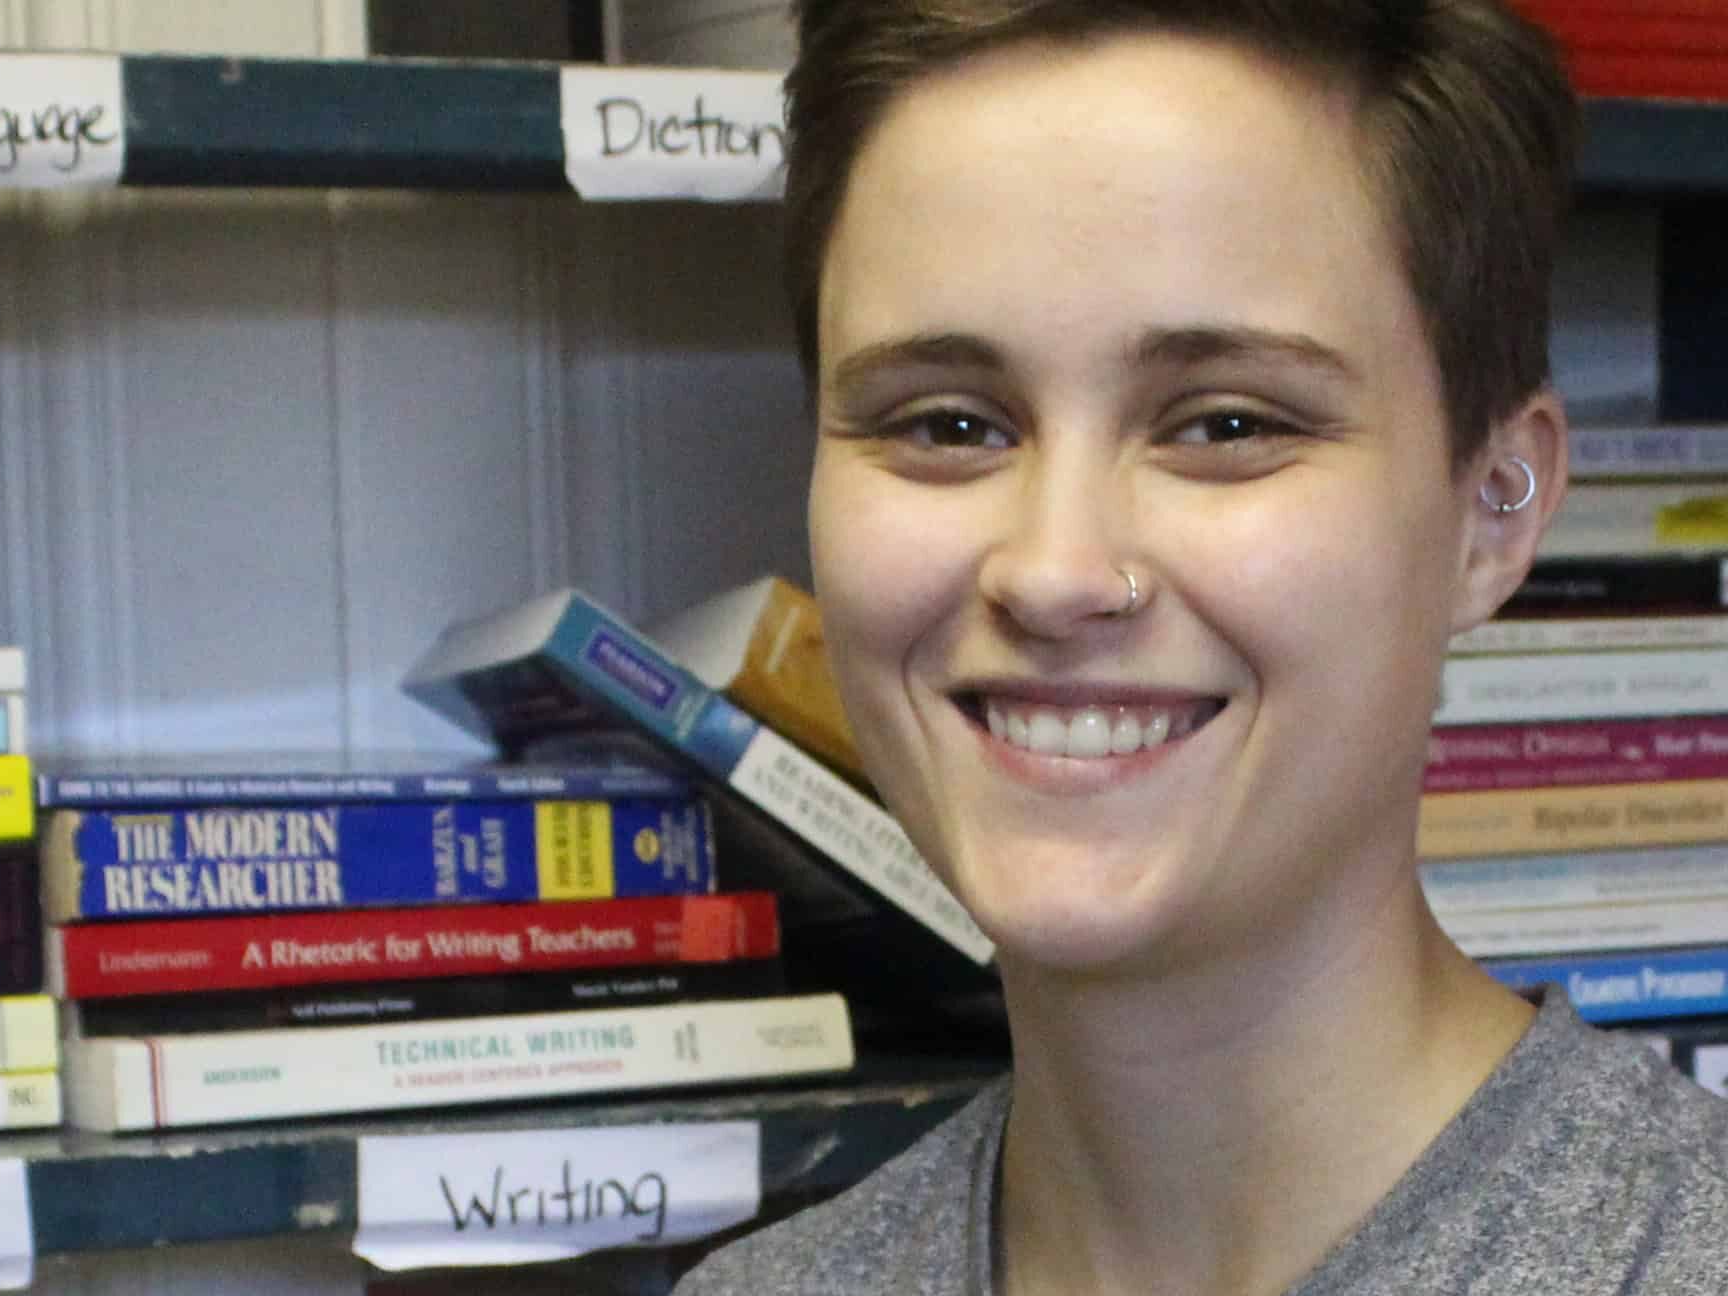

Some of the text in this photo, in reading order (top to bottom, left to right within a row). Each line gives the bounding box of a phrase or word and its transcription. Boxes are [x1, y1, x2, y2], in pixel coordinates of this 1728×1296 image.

[114, 807, 338, 863] THE MODERN
[102, 859, 343, 913] RESEARCHER
[99, 923, 636, 975] Lindemann A Rhetoric for Writing Teachers
[376, 1030, 514, 1066] TECHNICAL
[525, 1023, 636, 1054] WRITING
[438, 1157, 668, 1241] Writing
